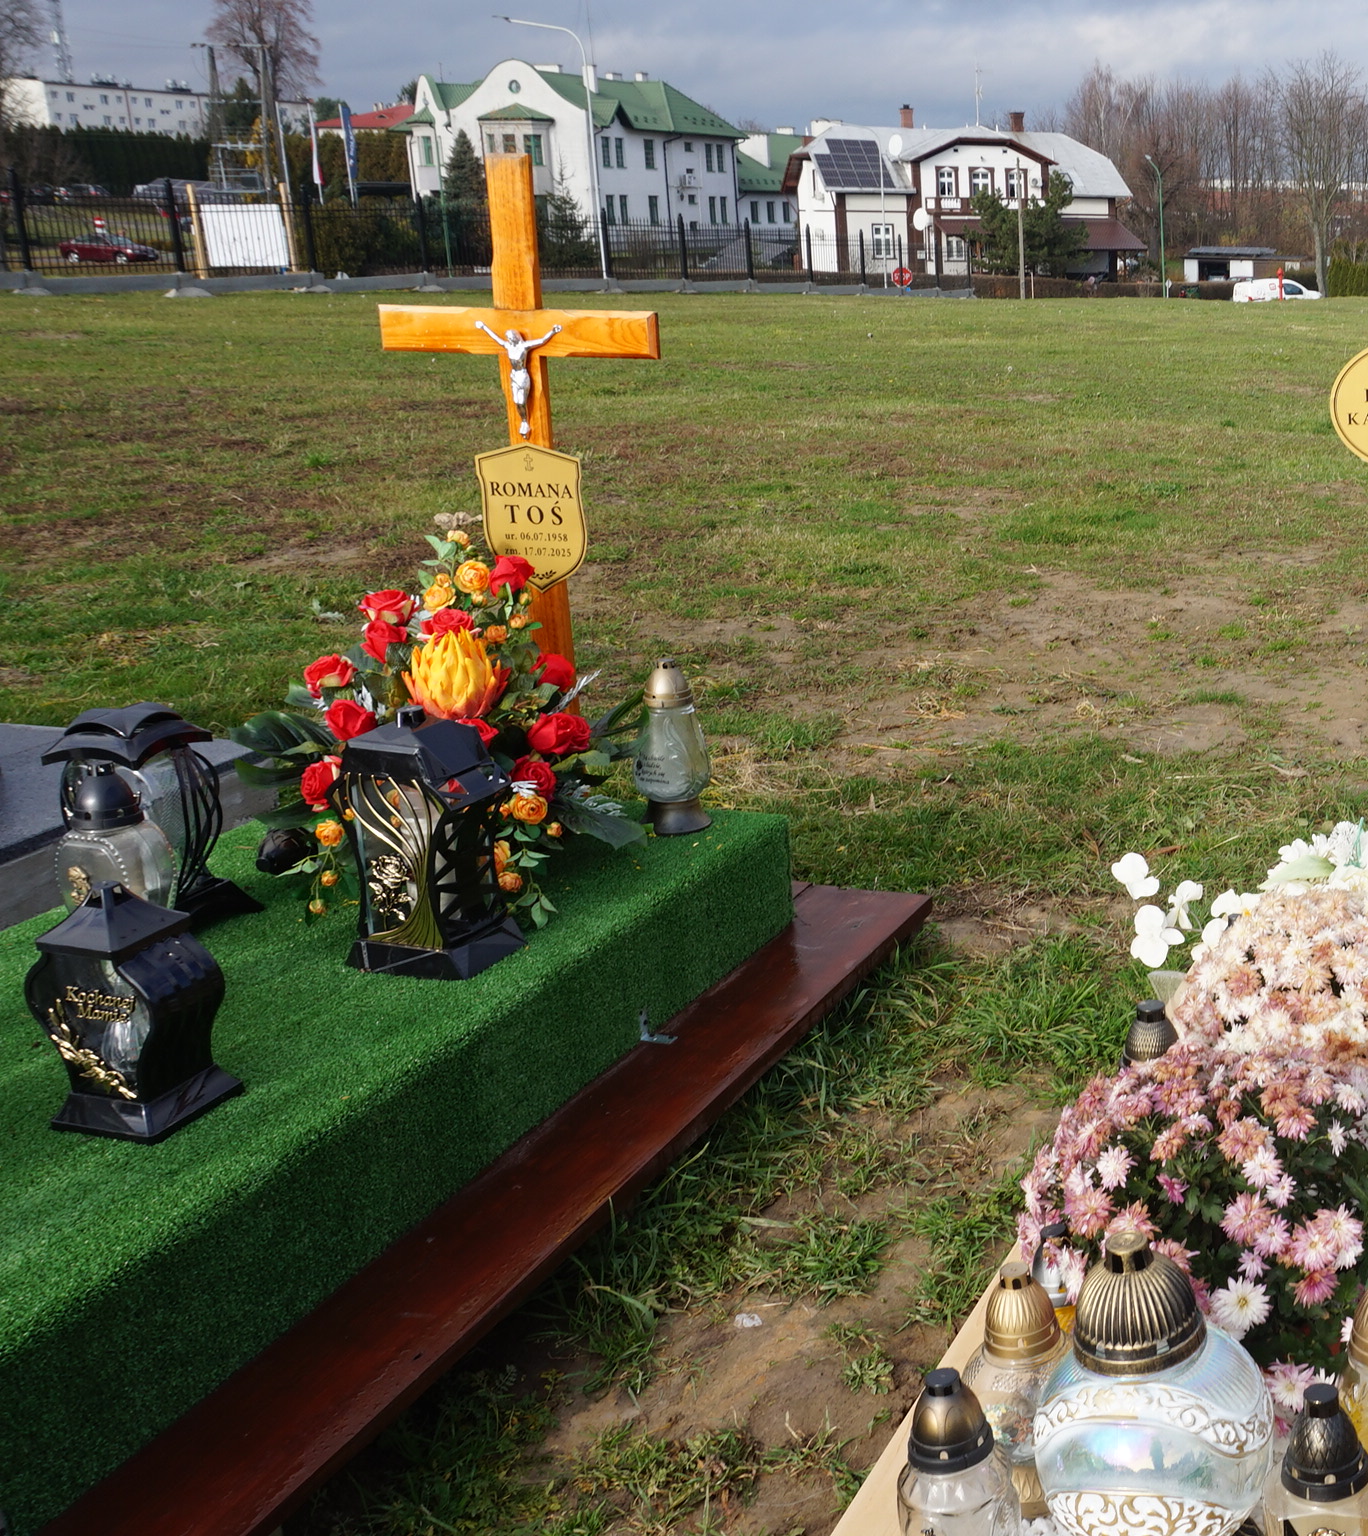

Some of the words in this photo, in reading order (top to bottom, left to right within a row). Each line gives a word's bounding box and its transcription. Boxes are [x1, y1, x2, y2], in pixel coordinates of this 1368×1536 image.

[489, 481, 573, 499] ROMANA
[504, 501, 563, 526] TOŚ
[505, 532, 517, 541] ur.
[520, 532, 568, 543] 06.07.1958
[504, 548, 521, 556] zm.
[524, 546, 572, 558] 17.07.2025
[65, 985, 136, 1014] Kochanej
[76, 1003, 129, 1023] Mamie
